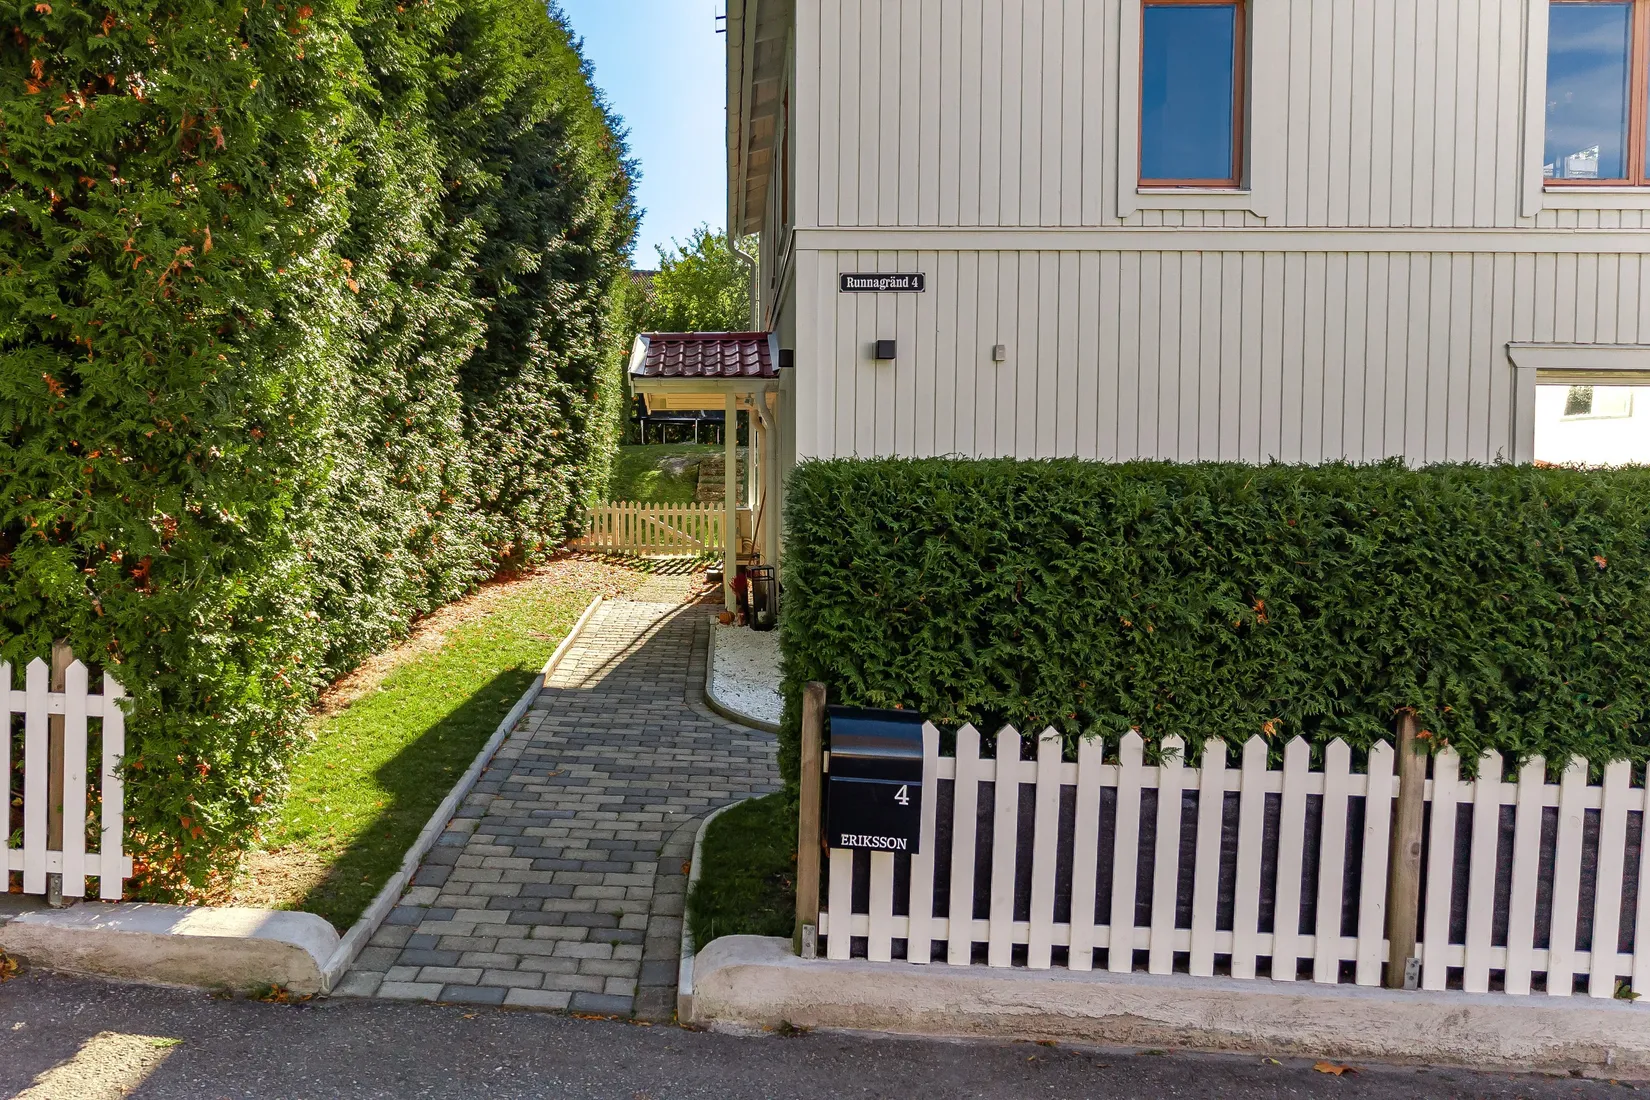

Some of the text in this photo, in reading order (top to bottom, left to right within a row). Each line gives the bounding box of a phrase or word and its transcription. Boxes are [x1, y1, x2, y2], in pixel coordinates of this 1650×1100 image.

[846, 276, 918, 290] Runnagränd 4
[894, 784, 909, 805] 4
[841, 834, 907, 850] ERIKSSON
